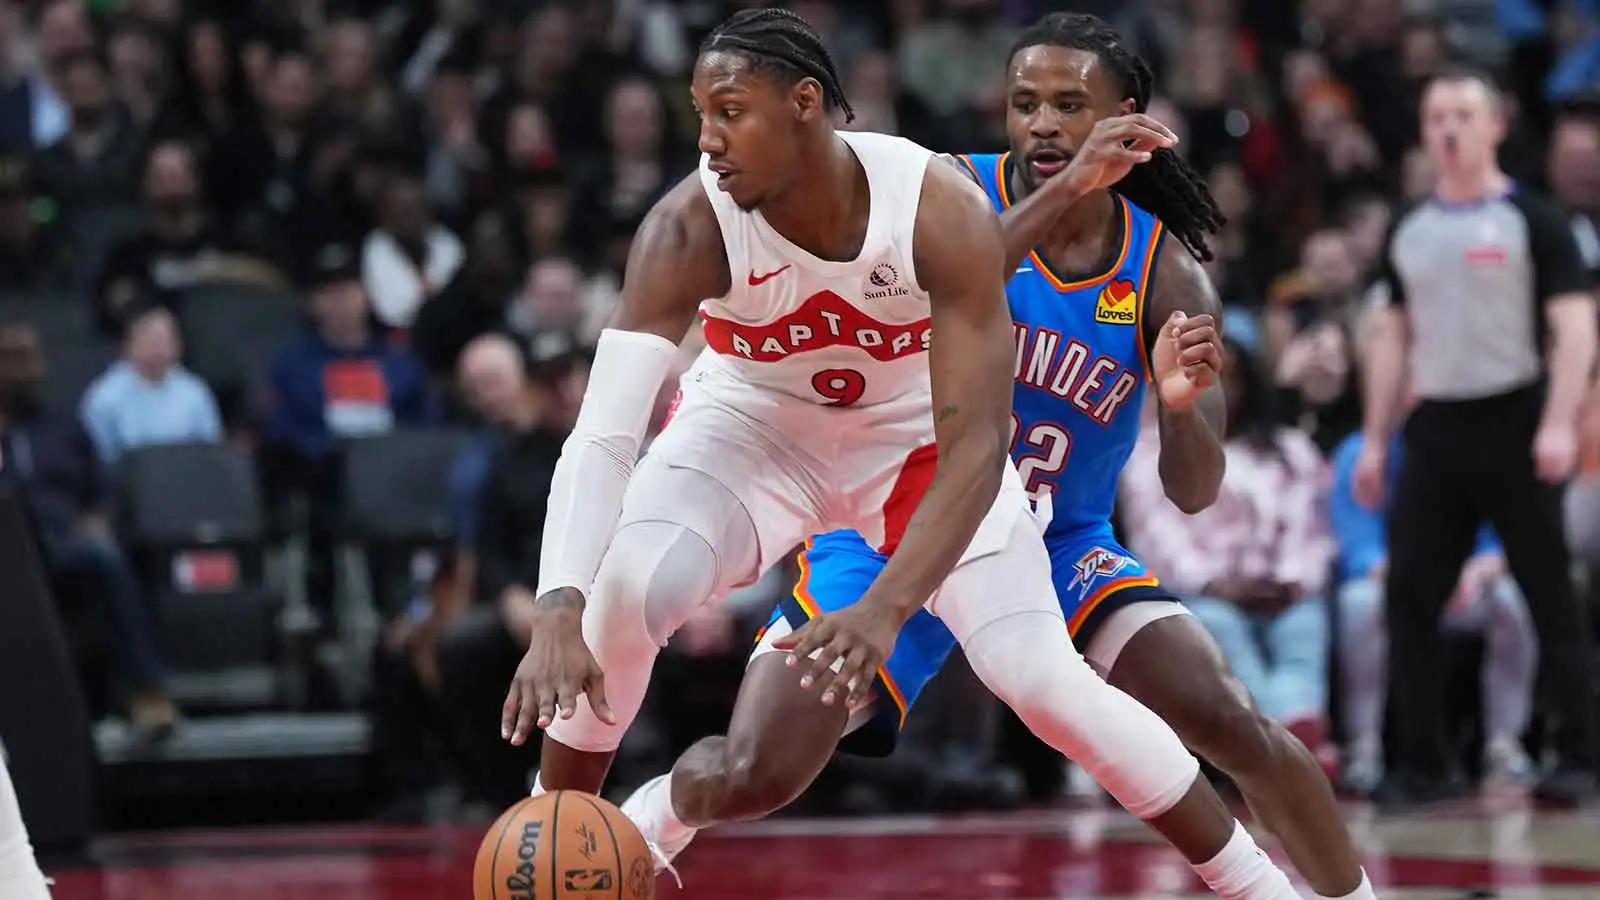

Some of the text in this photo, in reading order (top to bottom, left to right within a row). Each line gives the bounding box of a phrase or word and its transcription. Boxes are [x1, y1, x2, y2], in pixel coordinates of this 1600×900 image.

[863, 287, 909, 300] Sun Life
[1097, 306, 1134, 321] Love's
[811, 368, 866, 408] 9
[1009, 411, 1072, 502] 2
